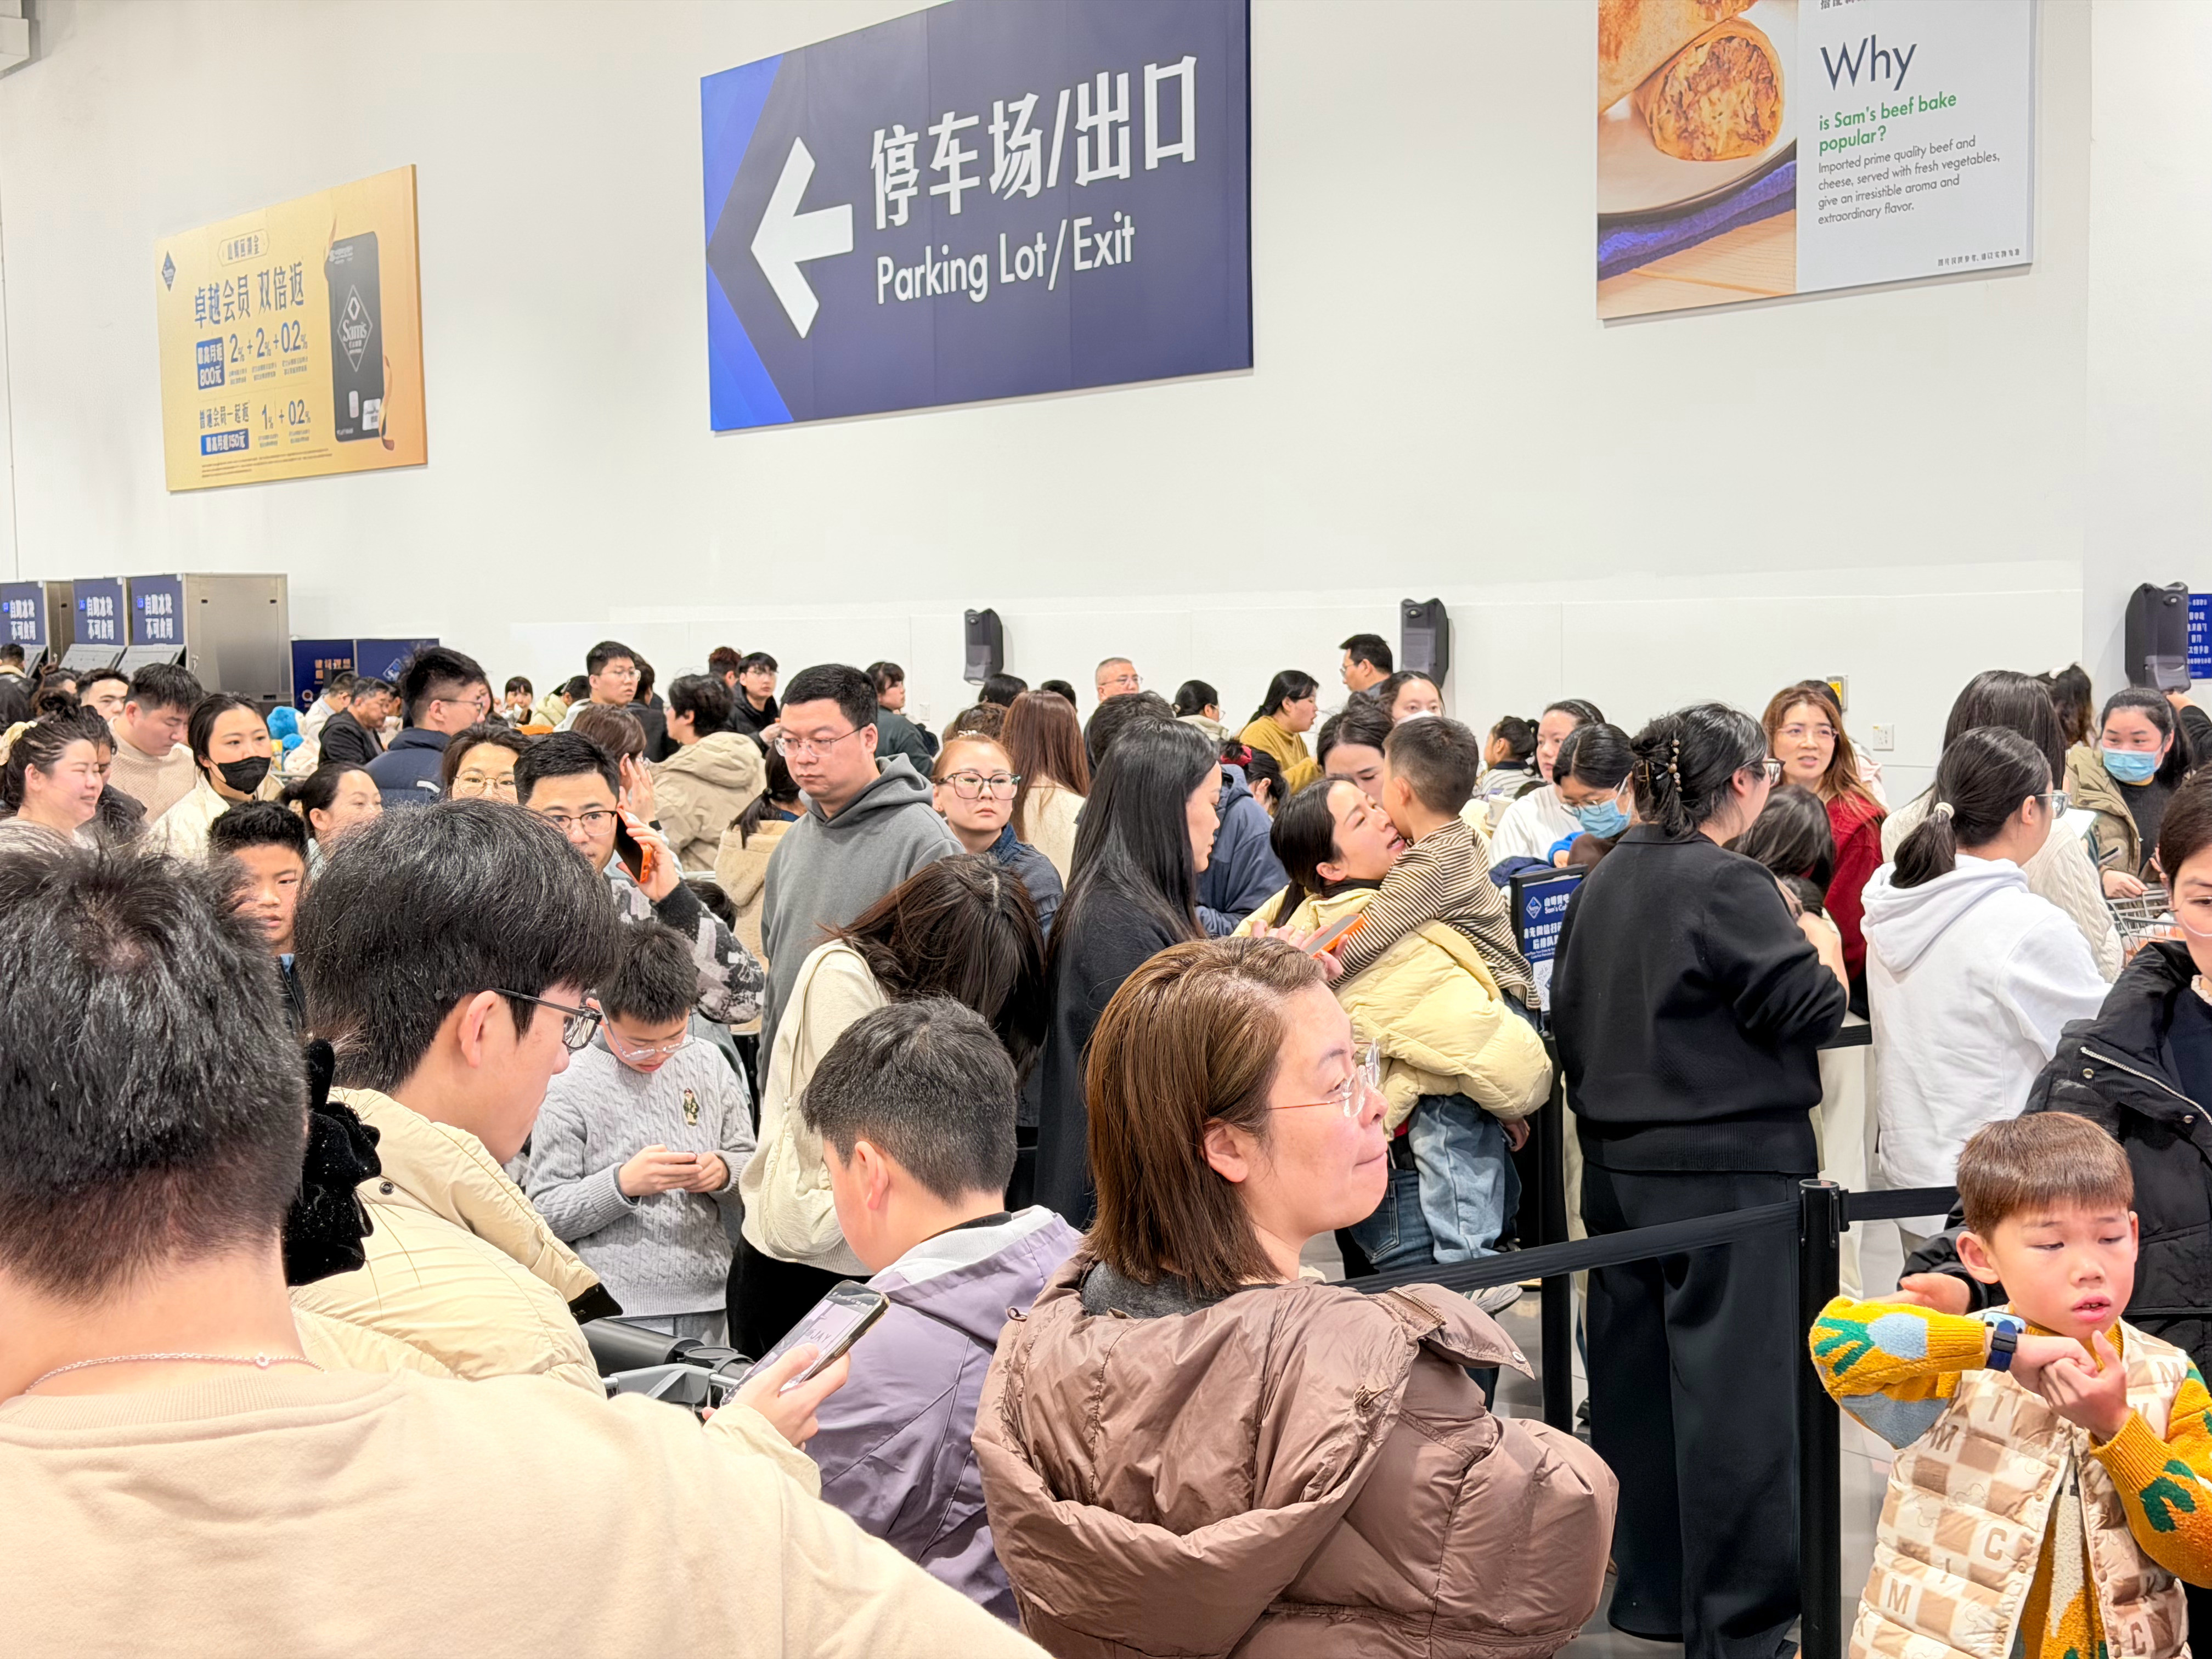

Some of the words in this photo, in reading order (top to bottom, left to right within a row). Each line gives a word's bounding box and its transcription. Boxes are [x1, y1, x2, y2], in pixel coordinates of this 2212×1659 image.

[1820, 34, 1917, 91] Why
[1819, 115, 1830, 131] is
[1834, 106, 1876, 128] Sam's
[1881, 97, 1914, 120] beef
[1918, 91, 1957, 113] bake
[871, 55, 1197, 230] 停车场/出口
[1818, 155, 1861, 174] Imported
[1864, 153, 1891, 168] prime
[1894, 145, 1926, 163] quality
[1929, 138, 1954, 154] beef
[1955, 134, 1976, 150] and
[1819, 125, 1886, 156] popular?
[1818, 177, 1854, 191] cheese,
[1857, 167, 1889, 185] served
[1892, 164, 1912, 178] with
[1914, 161, 1939, 174] fresh
[1941, 150, 2000, 171] vegetables,
[1818, 195, 1838, 211] give
[1840, 193, 1853, 205] an
[1855, 183, 1902, 202] irresistible
[1905, 179, 1937, 194] aroma
[1939, 173, 1960, 189] and
[1818, 205, 1882, 225] extraordinary
[1884, 201, 1915, 215] flavor.
[878, 245, 988, 304] Parking
[1000, 211, 1135, 291] Lot/Exit
[195, 274, 250, 329] 卓越会员
[257, 261, 304, 315] 双倍返
[229, 333, 245, 363] 2%
[256, 328, 271, 358] 2%
[200, 365, 222, 387] 800元
[199, 402, 250, 430] 普通会员一起返
[262, 404, 273, 430] 1%
[1545, 905, 1558, 914] Sam's
[1984, 1527, 2008, 1561] C
[1887, 1578, 1912, 1615] M
